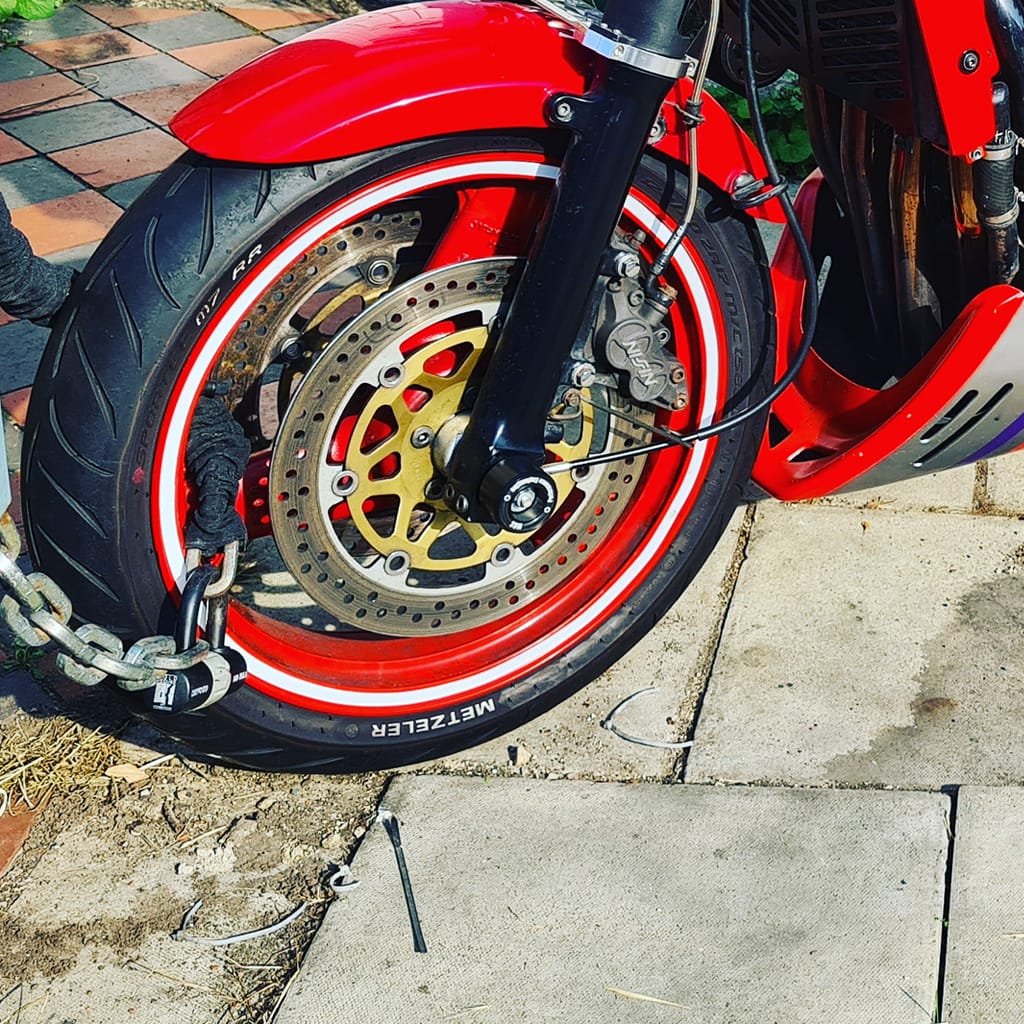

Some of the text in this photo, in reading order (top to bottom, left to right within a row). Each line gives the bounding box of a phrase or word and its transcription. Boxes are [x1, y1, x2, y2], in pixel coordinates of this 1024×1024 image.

[232, 243, 262, 280] RR
[622, 340, 659, 386] NISSIN
[371, 698, 496, 738] METZELER
